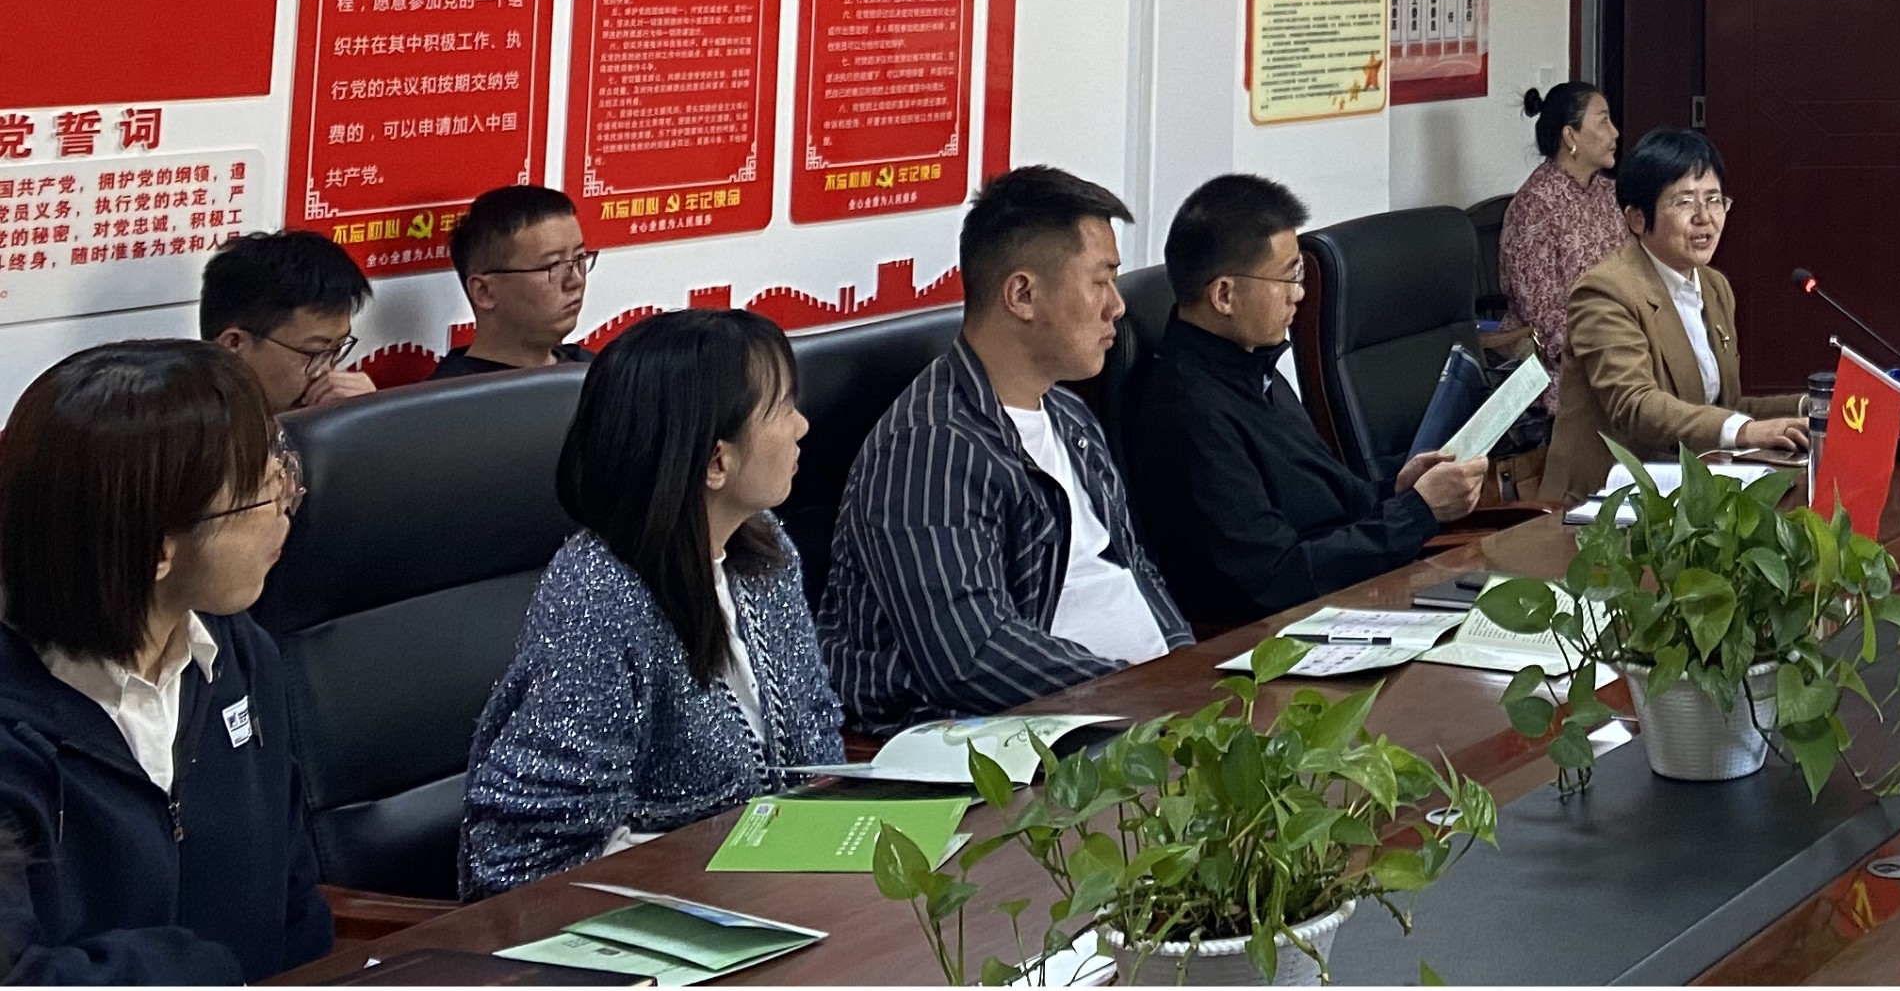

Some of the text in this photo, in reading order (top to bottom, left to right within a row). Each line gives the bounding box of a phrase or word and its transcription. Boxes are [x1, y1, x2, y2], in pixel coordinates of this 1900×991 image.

[334, 30, 521, 56] 织并在其中积极工作、执
[331, 71, 519, 100] 行党的决议和按期交纳党
[0, 108, 162, 158] 党誓词
[328, 112, 517, 145] 费的，可以申请加入中国
[325, 165, 384, 189] 共产党。
[824, 170, 871, 191] 不忘初心
[601, 189, 740, 220] 不忘初心 牢记使命
[332, 218, 400, 244] 不忘初心
[367, 245, 451, 268] 全心全意为人民
